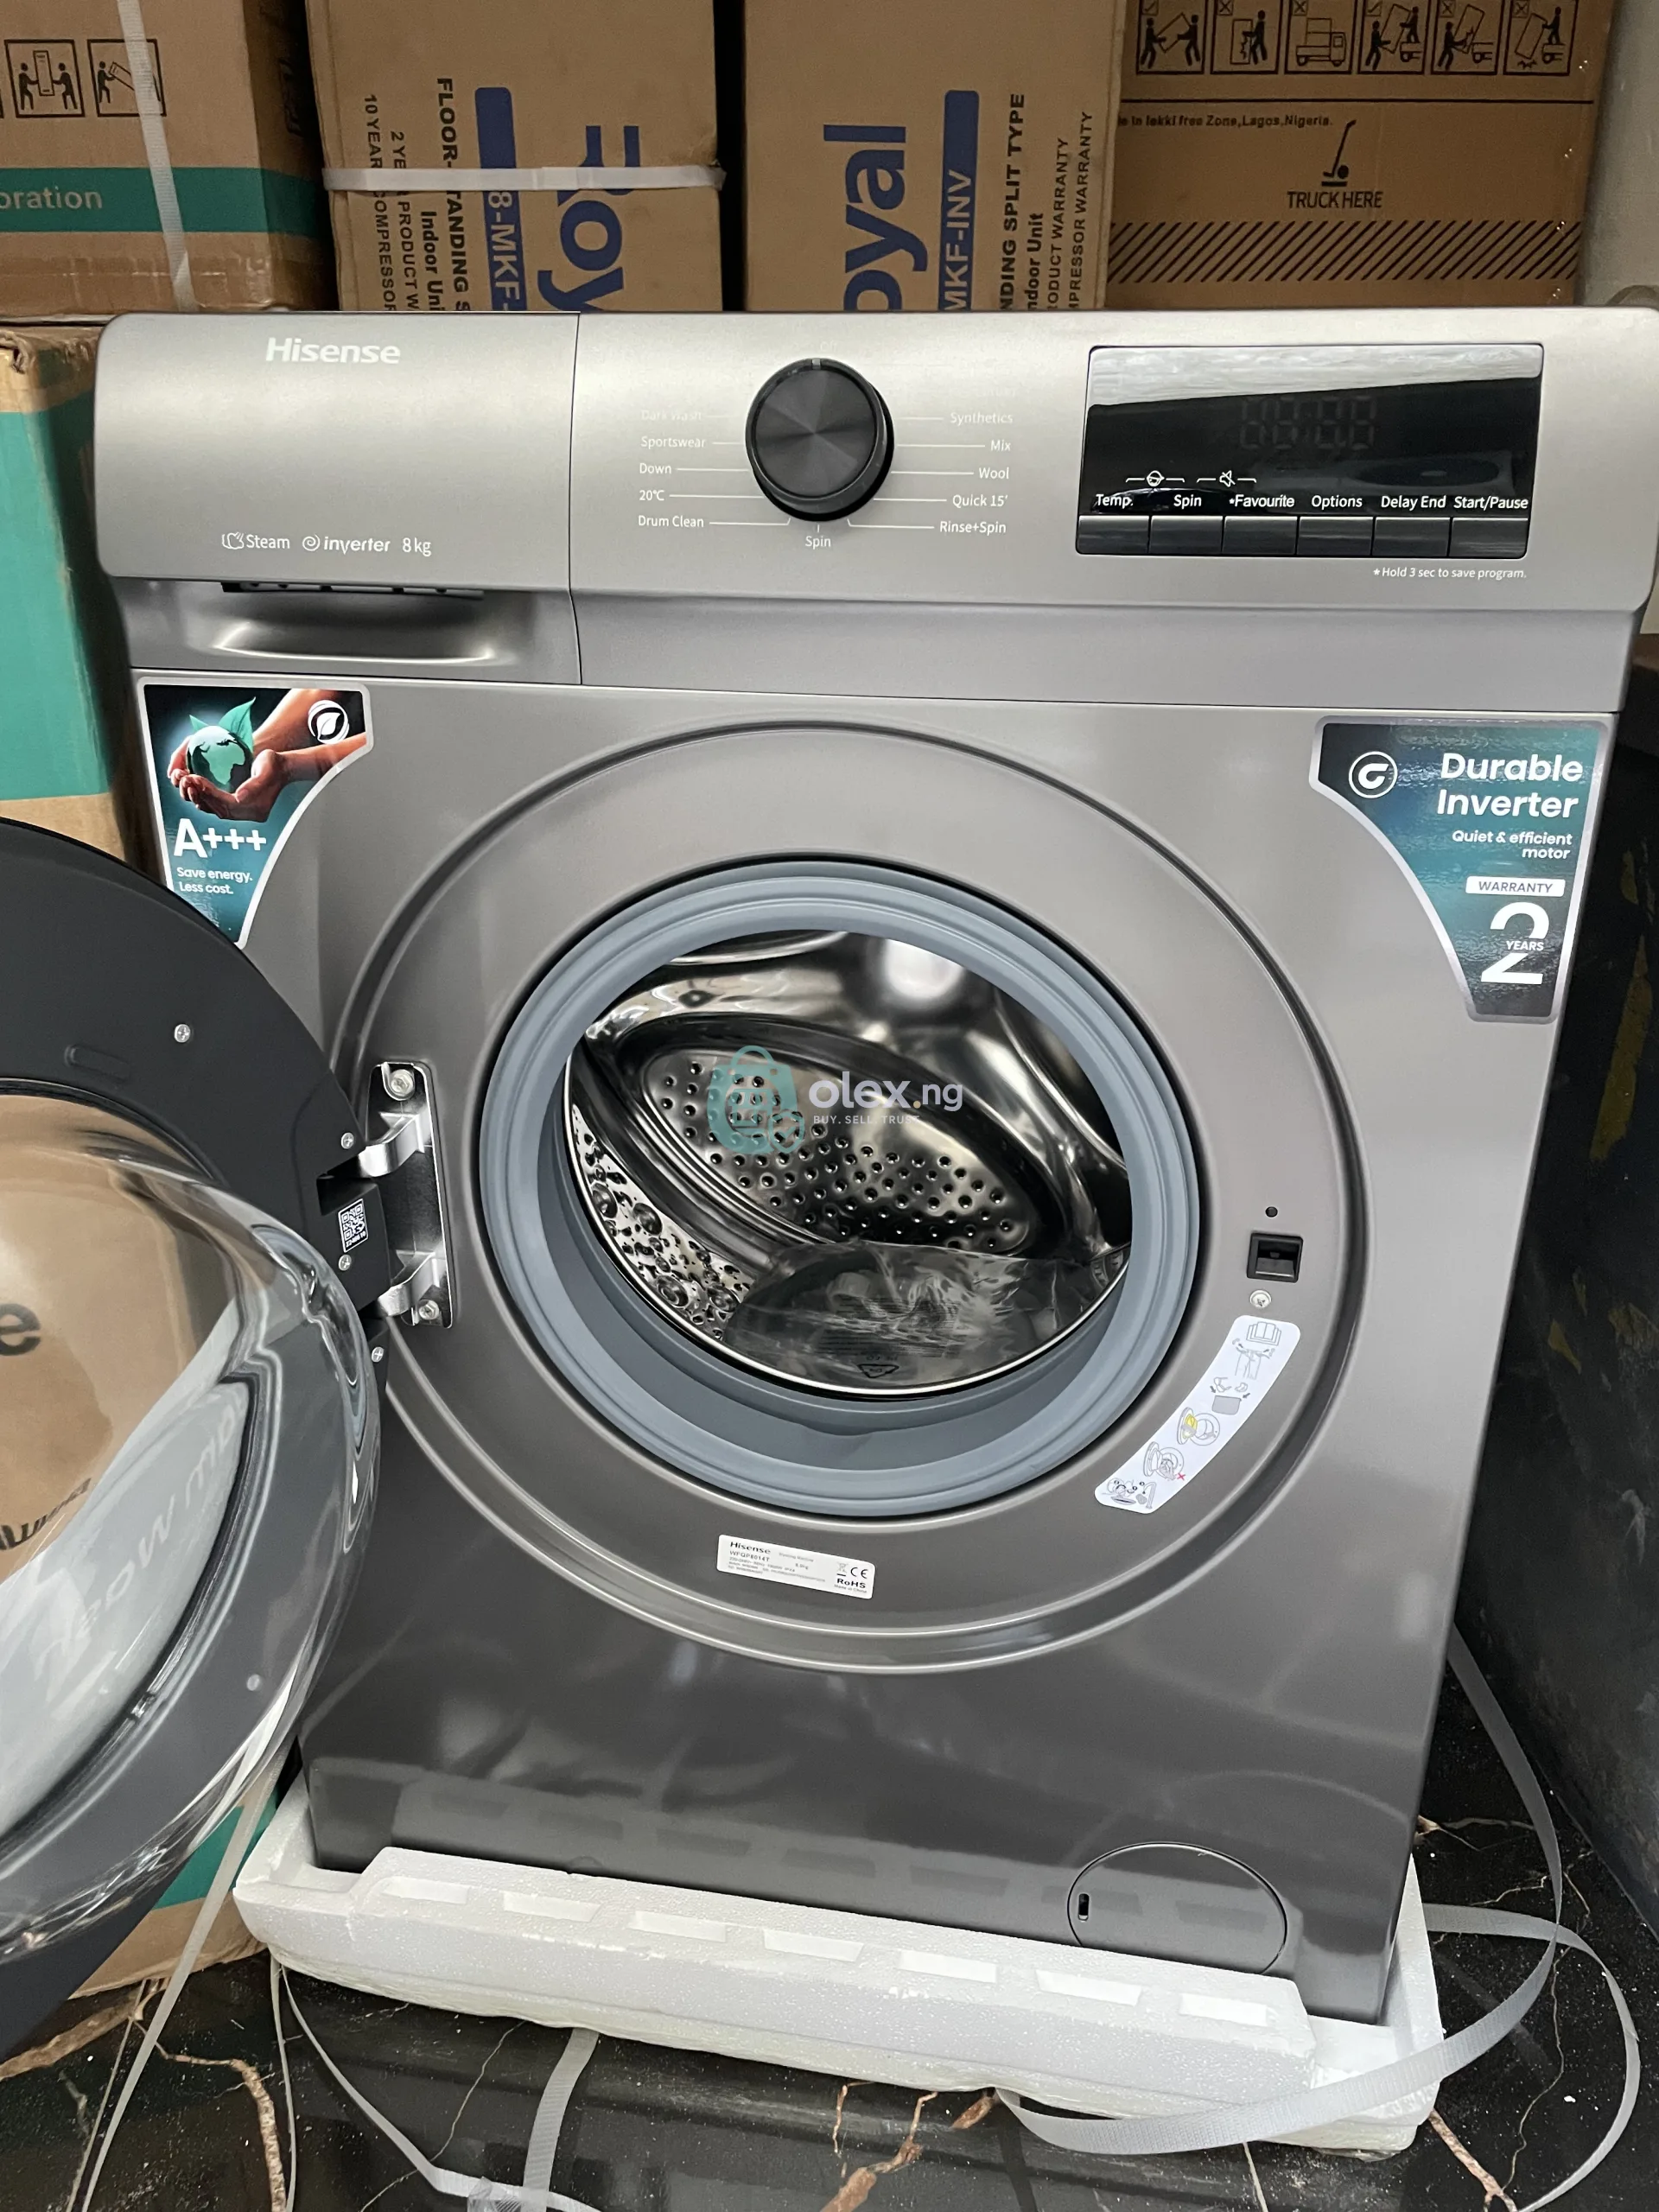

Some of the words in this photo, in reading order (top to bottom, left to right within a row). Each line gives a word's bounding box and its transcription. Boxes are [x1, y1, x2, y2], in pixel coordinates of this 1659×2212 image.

[1007, 93, 1025, 156] TYPE
[1074, 111, 1093, 213] WARRANTY
[1051, 137, 1069, 239] WARRANTY
[1004, 164, 1021, 232] SPLIT
[1287, 191, 1338, 209] TRUCK
[1342, 191, 1384, 209] HERE
[1027, 213, 1044, 252] Unit
[397, 201, 418, 289] PRODUCT
[420, 211, 439, 273] Indoor
[427, 280, 445, 311] Uni
[265, 337, 401, 364] Hisense
[950, 411, 1014, 426] Synthetics
[640, 435, 706, 449] Sportswear
[990, 439, 1011, 451] Mix
[639, 463, 672, 474] Down
[978, 467, 1009, 479] Wool
[952, 494, 987, 508] Quick
[1095, 493, 1133, 508] Temp.
[1173, 494, 1202, 510] Spin
[1311, 494, 1363, 510] Options
[1381, 495, 1418, 510] Delay
[1421, 495, 1446, 508] End
[1453, 495, 1529, 511] Start/Pause
[638, 516, 670, 527] Drum
[672, 516, 704, 528] Clean
[939, 520, 1007, 536] Rinse+Spin
[246, 534, 290, 549] Steam
[323, 536, 391, 555] inverter
[804, 536, 831, 550] Spin
[1382, 567, 1407, 577] Hold
[1409, 567, 1416, 577] 3
[1418, 569, 1435, 577] sec
[1438, 568, 1449, 577] to
[1478, 569, 1527, 580] program.
[1440, 753, 1583, 782] Durable
[1437, 789, 1579, 818] Inverter
[173, 817, 267, 858] A+++
[1452, 830, 1493, 843] Quiet
[1496, 831, 1506, 843] &
[1509, 831, 1573, 845] efficient
[1522, 846, 1571, 860] motor
[176, 867, 206, 878] Save
[207, 870, 253, 884] energy.
[178, 881, 203, 892] Less
[205, 884, 234, 894] cost.
[1478, 880, 1554, 893] WARRANTY
[1480, 901, 1550, 985] 2
[1506, 940, 1544, 951] YEARS
[730, 1541, 771, 1554] Hisense
[836, 1578, 866, 1589] RoHS
